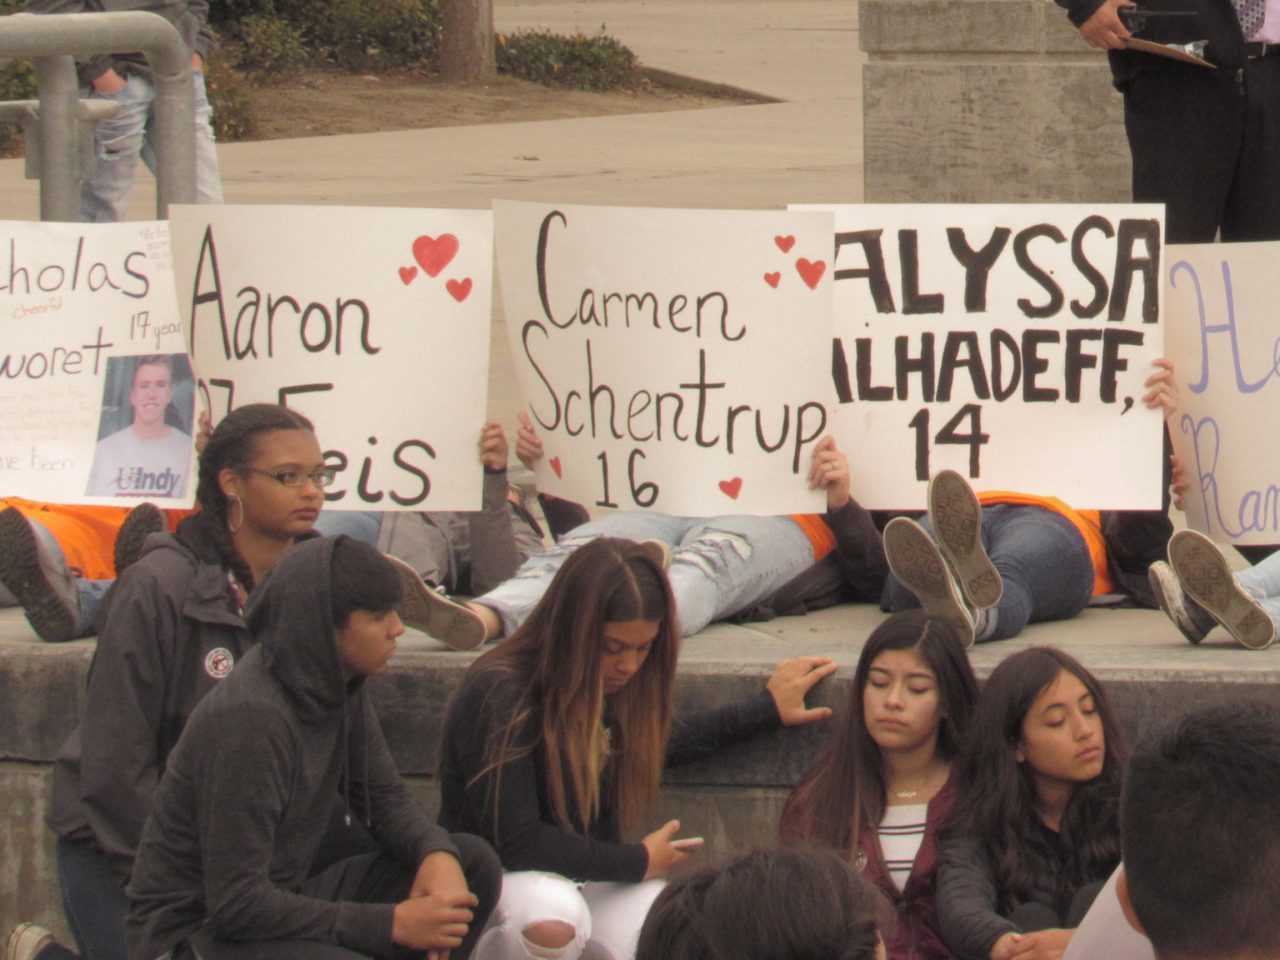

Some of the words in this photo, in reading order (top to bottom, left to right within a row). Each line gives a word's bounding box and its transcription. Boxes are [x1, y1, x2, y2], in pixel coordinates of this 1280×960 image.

[130, 311, 149, 341] 17
[190, 224, 381, 361] Aaron
[536, 209, 747, 341] Carmen
[521, 319, 828, 474] Schentrup
[908, 403, 990, 482] 14
[596, 448, 659, 509] 16
